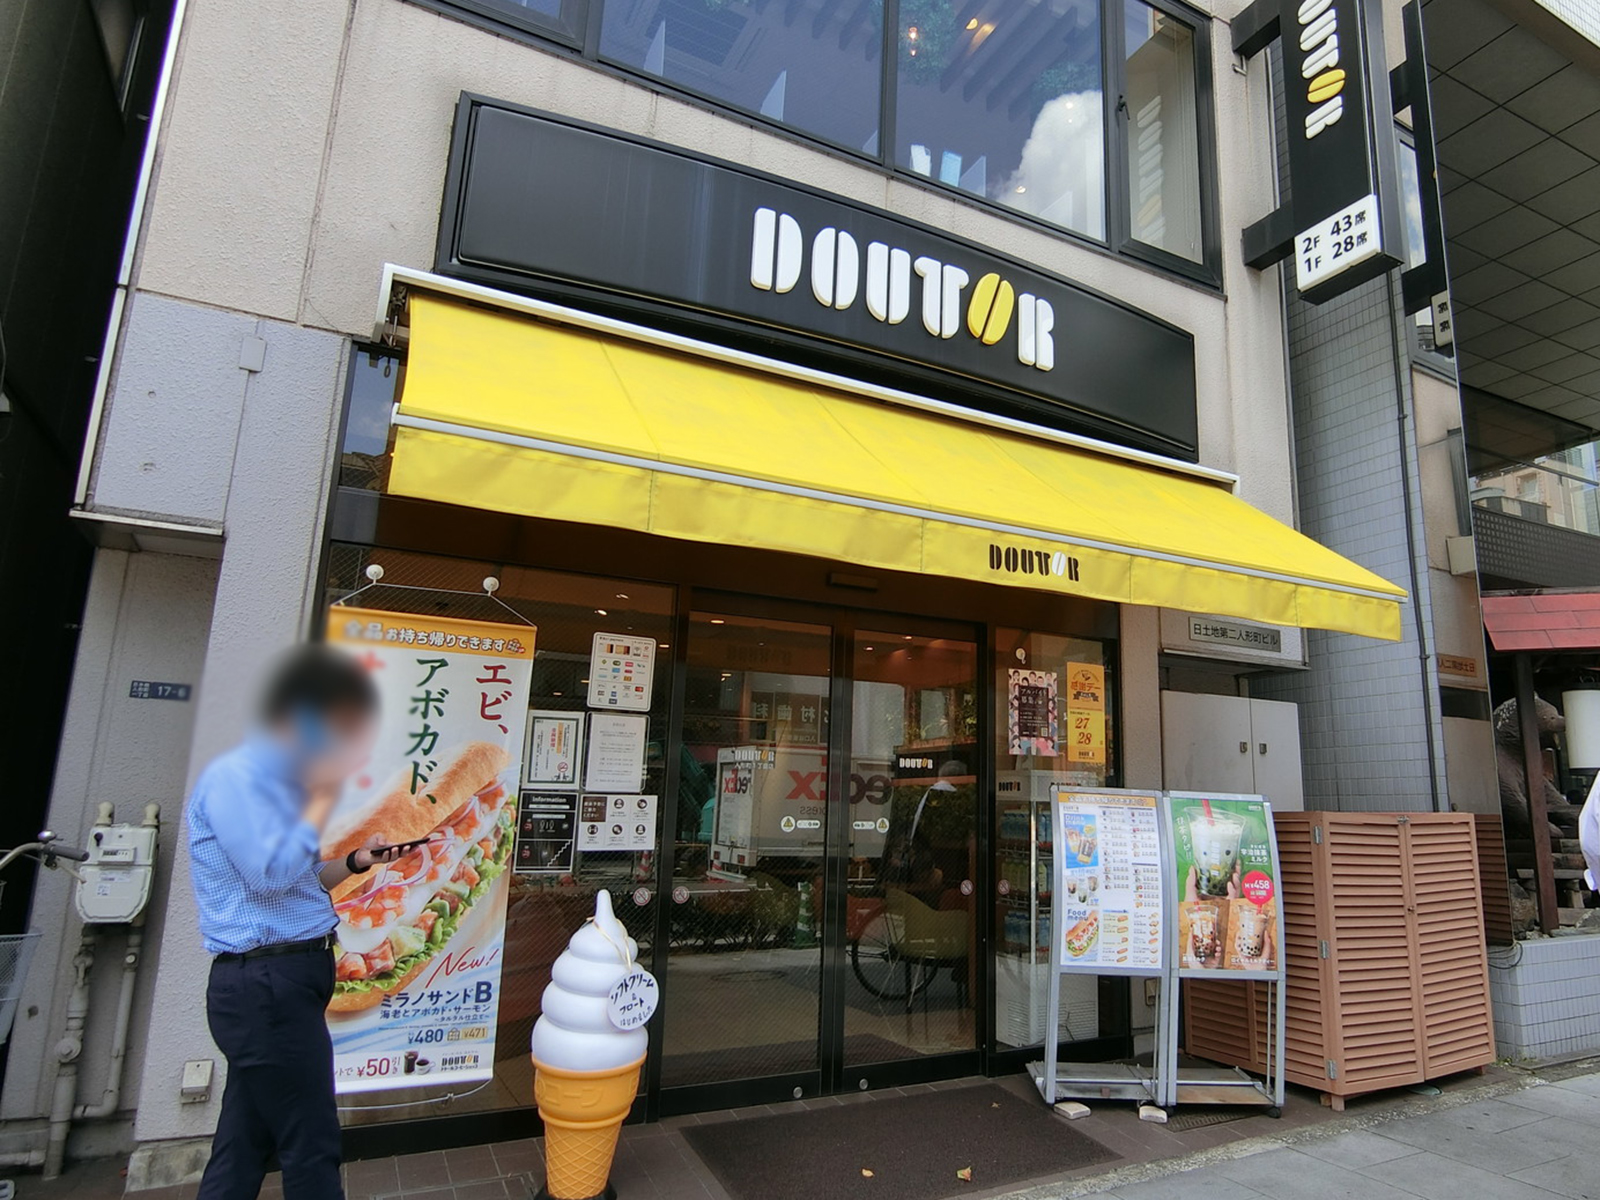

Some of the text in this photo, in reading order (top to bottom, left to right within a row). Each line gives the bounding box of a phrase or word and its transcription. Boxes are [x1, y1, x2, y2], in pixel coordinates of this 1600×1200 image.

[1302, 210, 1366, 254] 2F 43席
[1304, 231, 1368, 273] 1F 28席
[750, 207, 1055, 371] DOUTOR
[989, 544, 1079, 582] DOUTOR
[1193, 623, 1278, 645] 日土地第二人形町ビル
[476, 663, 513, 735] エビ、
[405, 657, 449, 805] アボカド、
[1075, 718, 1090, 729] 27
[1077, 732, 1092, 745] 28
[735, 750, 775, 761] DOUTOR
[900, 758, 933, 769] DOUTOR
[425, 946, 500, 988] New!
[380, 981, 493, 1008] ミラノサンドB
[610, 973, 654, 1005] ソフトクリーム
[380, 1005, 491, 1020] 海老とアボカド・サーモン
[619, 997, 644, 1015] フロート
[408, 1027, 487, 1044] ¥480 ¥471
[357, 1058, 390, 1077] ¥50
[441, 1055, 479, 1066] DOUTOR
